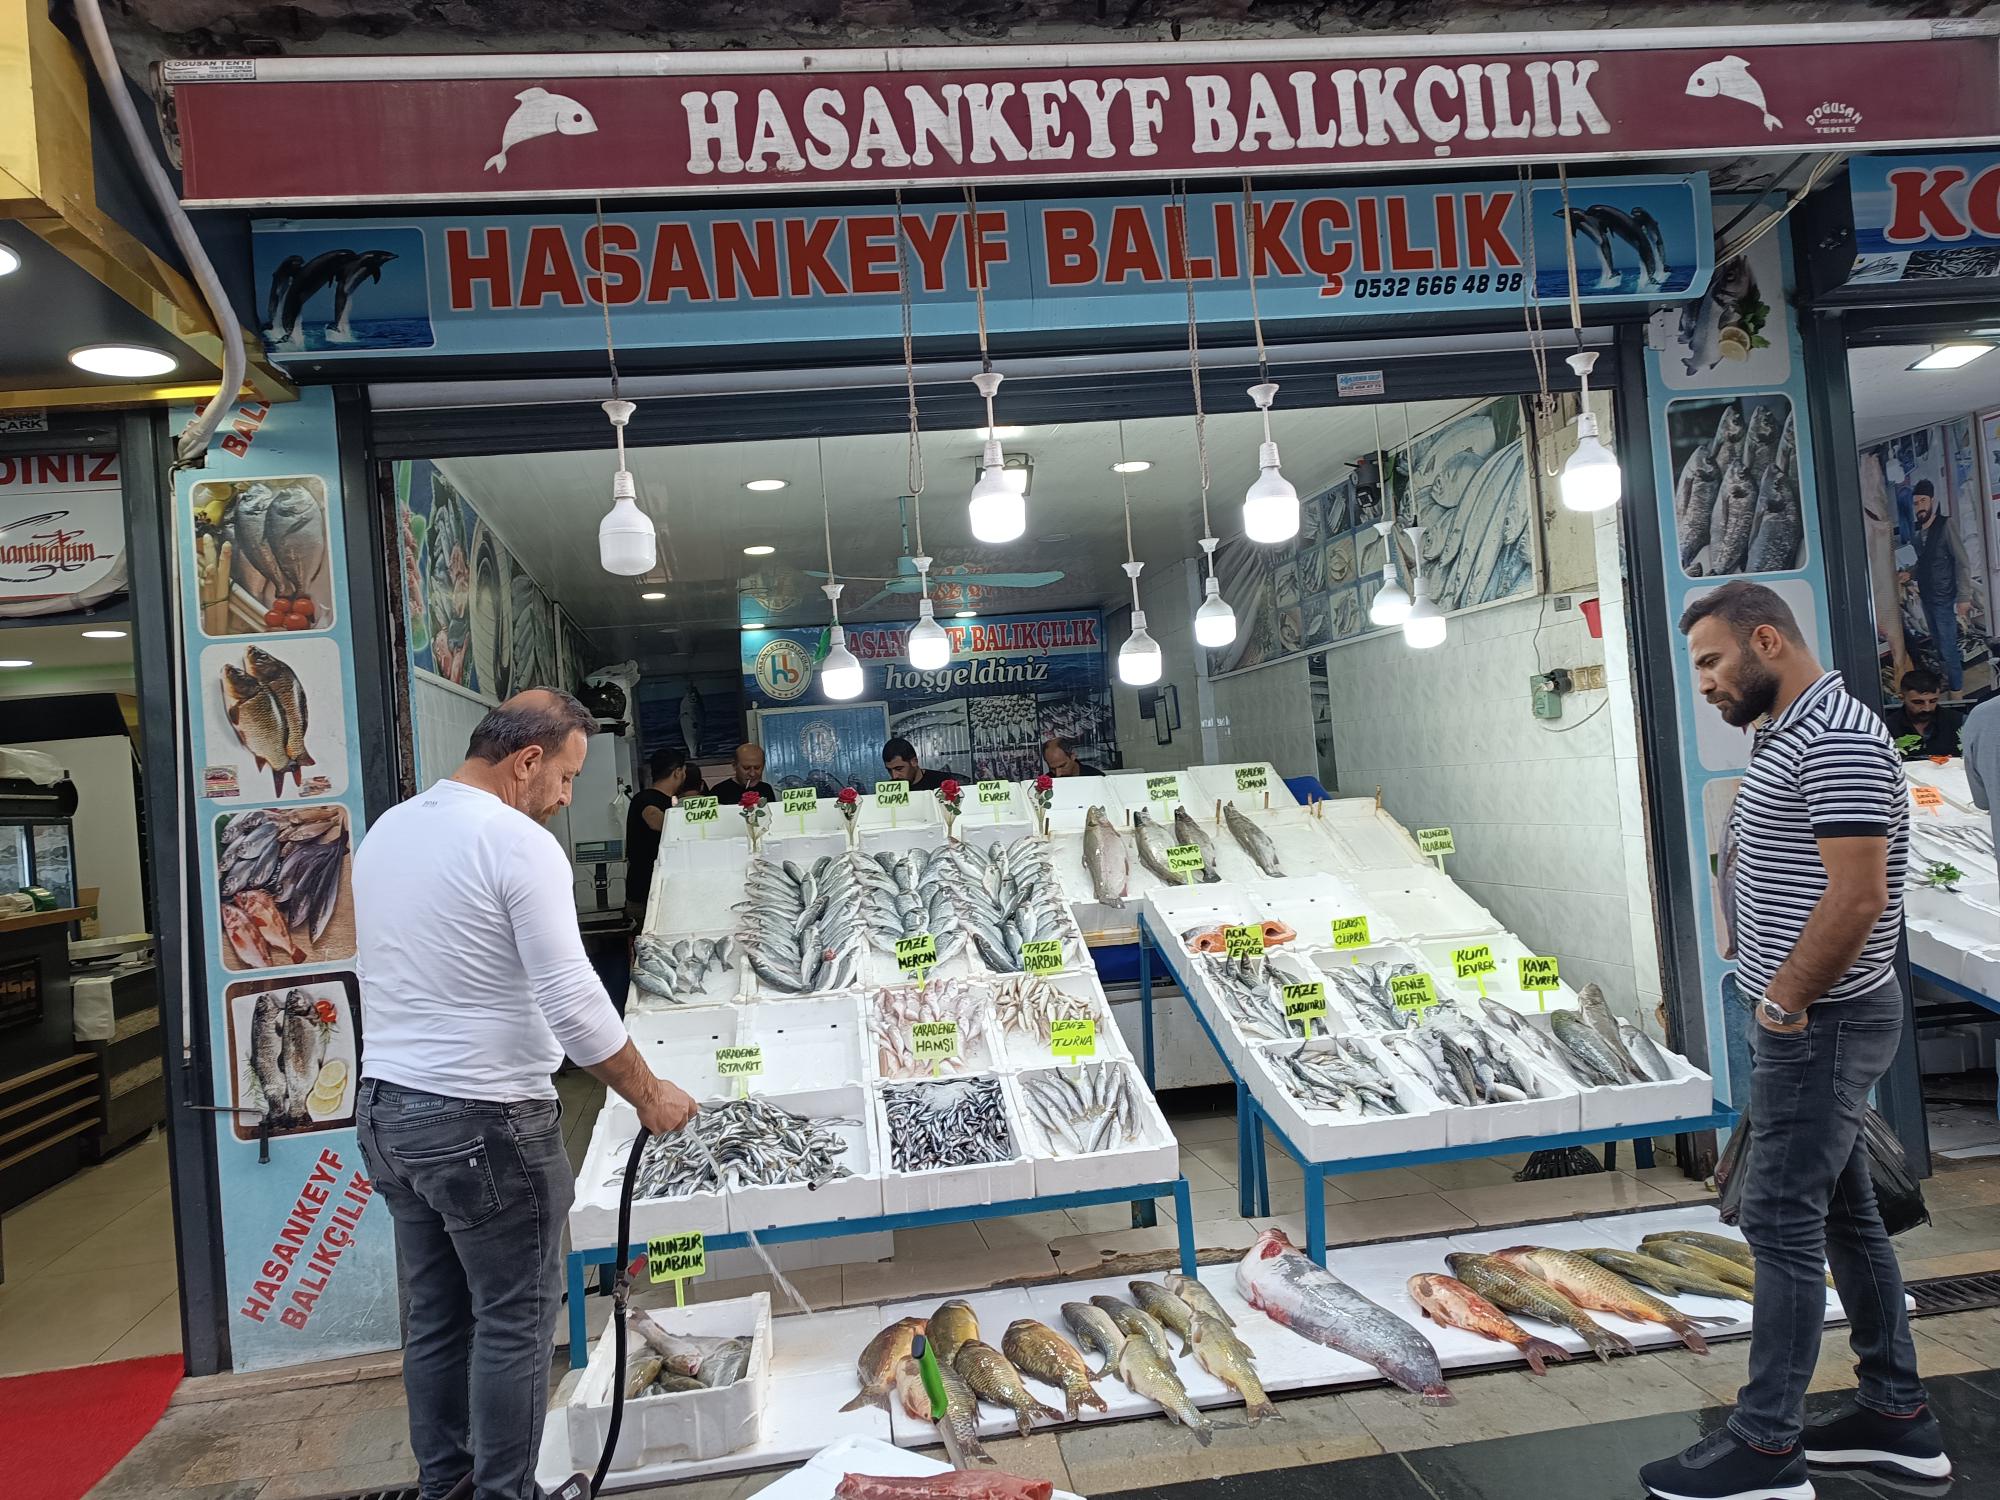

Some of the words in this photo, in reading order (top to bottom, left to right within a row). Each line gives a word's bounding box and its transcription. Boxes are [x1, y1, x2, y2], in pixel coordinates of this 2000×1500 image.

[680, 76, 1170, 175] HASANKEYF
[1185, 60, 1612, 157] BALIKÇILIK
[444, 211, 1010, 311] HASANKEYF
[1042, 191, 1524, 298] BALIKÇILIK
[1354, 277, 1410, 298] 0532
[1416, 275, 1458, 295] 666
[1463, 274, 1490, 294] 48
[1496, 272, 1523, 293] 98
[970, 620, 1098, 657] BALIKÇILIK
[885, 656, 1049, 693] hoşgeldiniz
[1237, 778, 1267, 791] SOMON
[878, 792, 910, 804] ÇUPRA
[979, 791, 1011, 803] LEVREK
[685, 808, 719, 822] ÇUPRA
[784, 800, 817, 813] LEVREK
[896, 935, 929, 954] TAZE
[1024, 943, 1058, 955] TAZE
[897, 950, 938, 970] MERCAN
[1456, 946, 1489, 963] KUM
[1457, 961, 1497, 978] LEVREK
[1522, 959, 1551, 972] KAYA
[1522, 973, 1560, 987] LEVREK
[1284, 983, 1319, 999] TAZE
[1395, 990, 1432, 1006] KEFAL
[1051, 1034, 1094, 1047] TURNA
[240, 1147, 344, 1323] HASANKEYF
[279, 1170, 374, 1331] BALIKÇILIK
[648, 1233, 703, 1258] MUNZUR
[649, 1252, 704, 1279] ALABALIK
